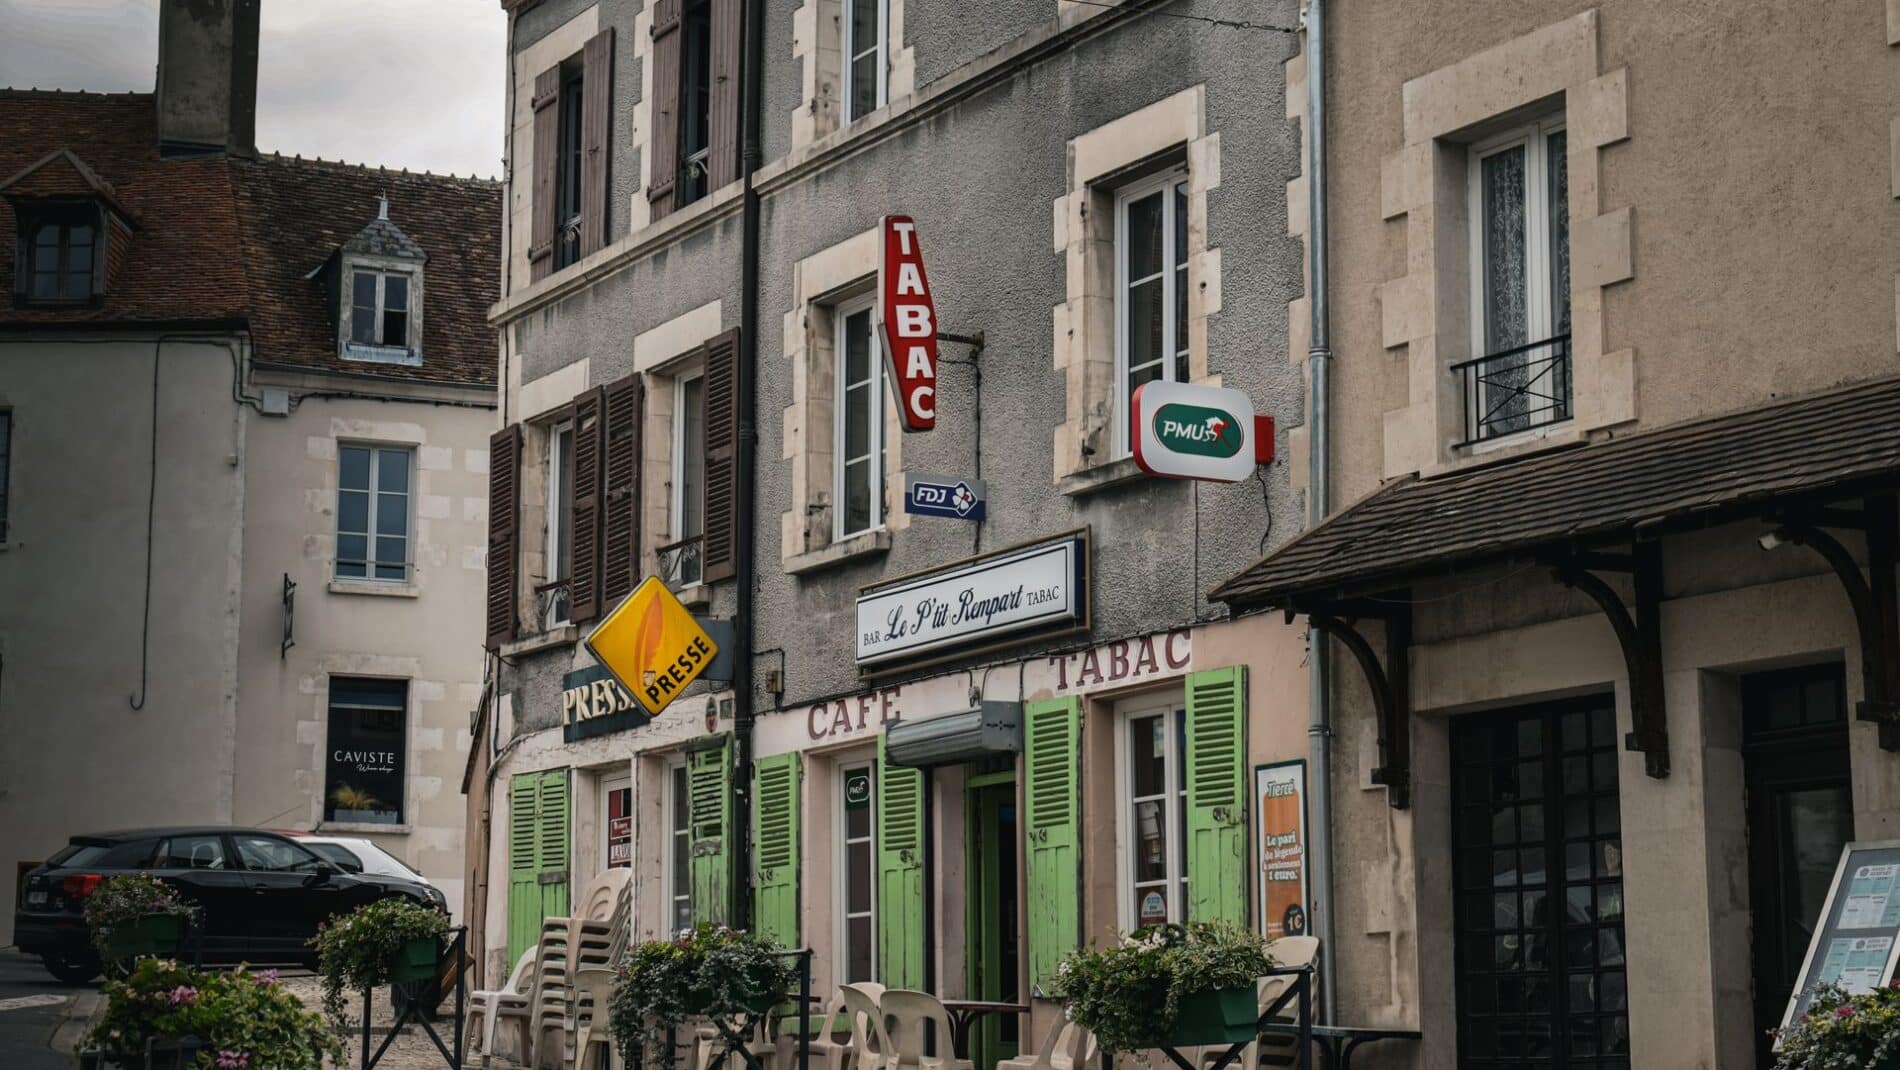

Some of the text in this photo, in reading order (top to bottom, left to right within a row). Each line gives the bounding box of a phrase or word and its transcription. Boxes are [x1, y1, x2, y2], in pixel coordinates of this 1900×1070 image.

[893, 222, 935, 420] TABAC
[1163, 420, 1205, 441] PMU
[916, 486, 947, 504] FDJ
[863, 585, 1060, 646] BAR Le P'tit Rempart TABAC
[645, 636, 710, 704] PRESSE
[1049, 627, 1191, 690] TABAC
[562, 678, 636, 726] PRESS
[334, 750, 395, 764] CAVISTE
[1266, 830, 1296, 848] Le pari
[1269, 870, 1298, 881] 1 euro.
